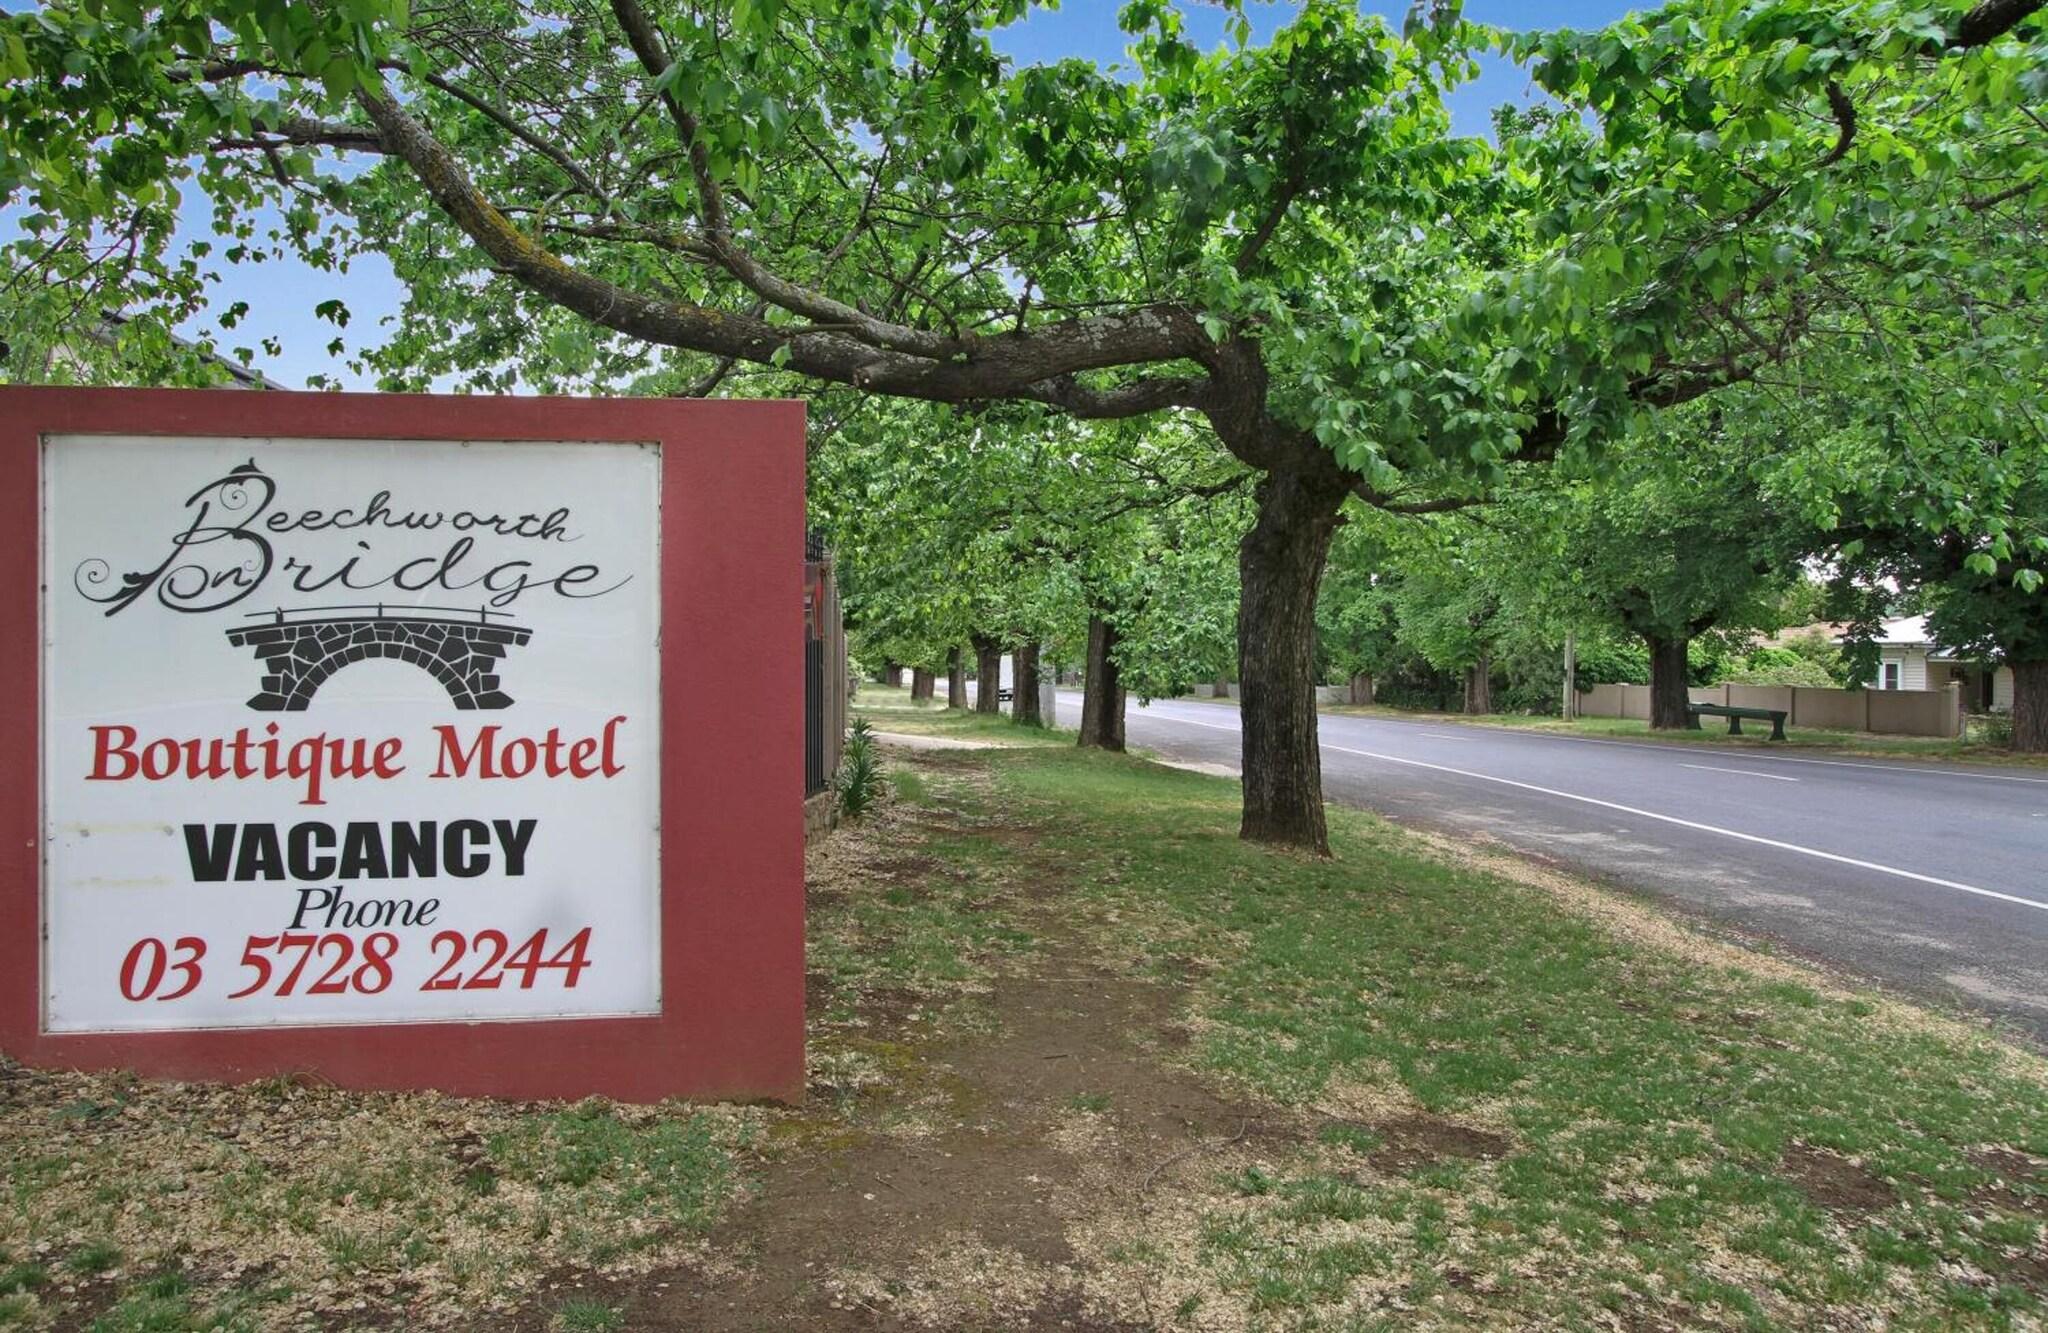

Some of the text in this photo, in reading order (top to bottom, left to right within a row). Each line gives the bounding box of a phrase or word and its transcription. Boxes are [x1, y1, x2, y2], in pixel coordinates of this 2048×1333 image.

[172, 457, 584, 544] Beechworth
[158, 535, 635, 613] on Bridge
[85, 715, 627, 805] Boutique Motel
[182, 818, 538, 883] VACANCY
[285, 885, 440, 930] Phone
[119, 927, 592, 1002] 03 5728 2244
